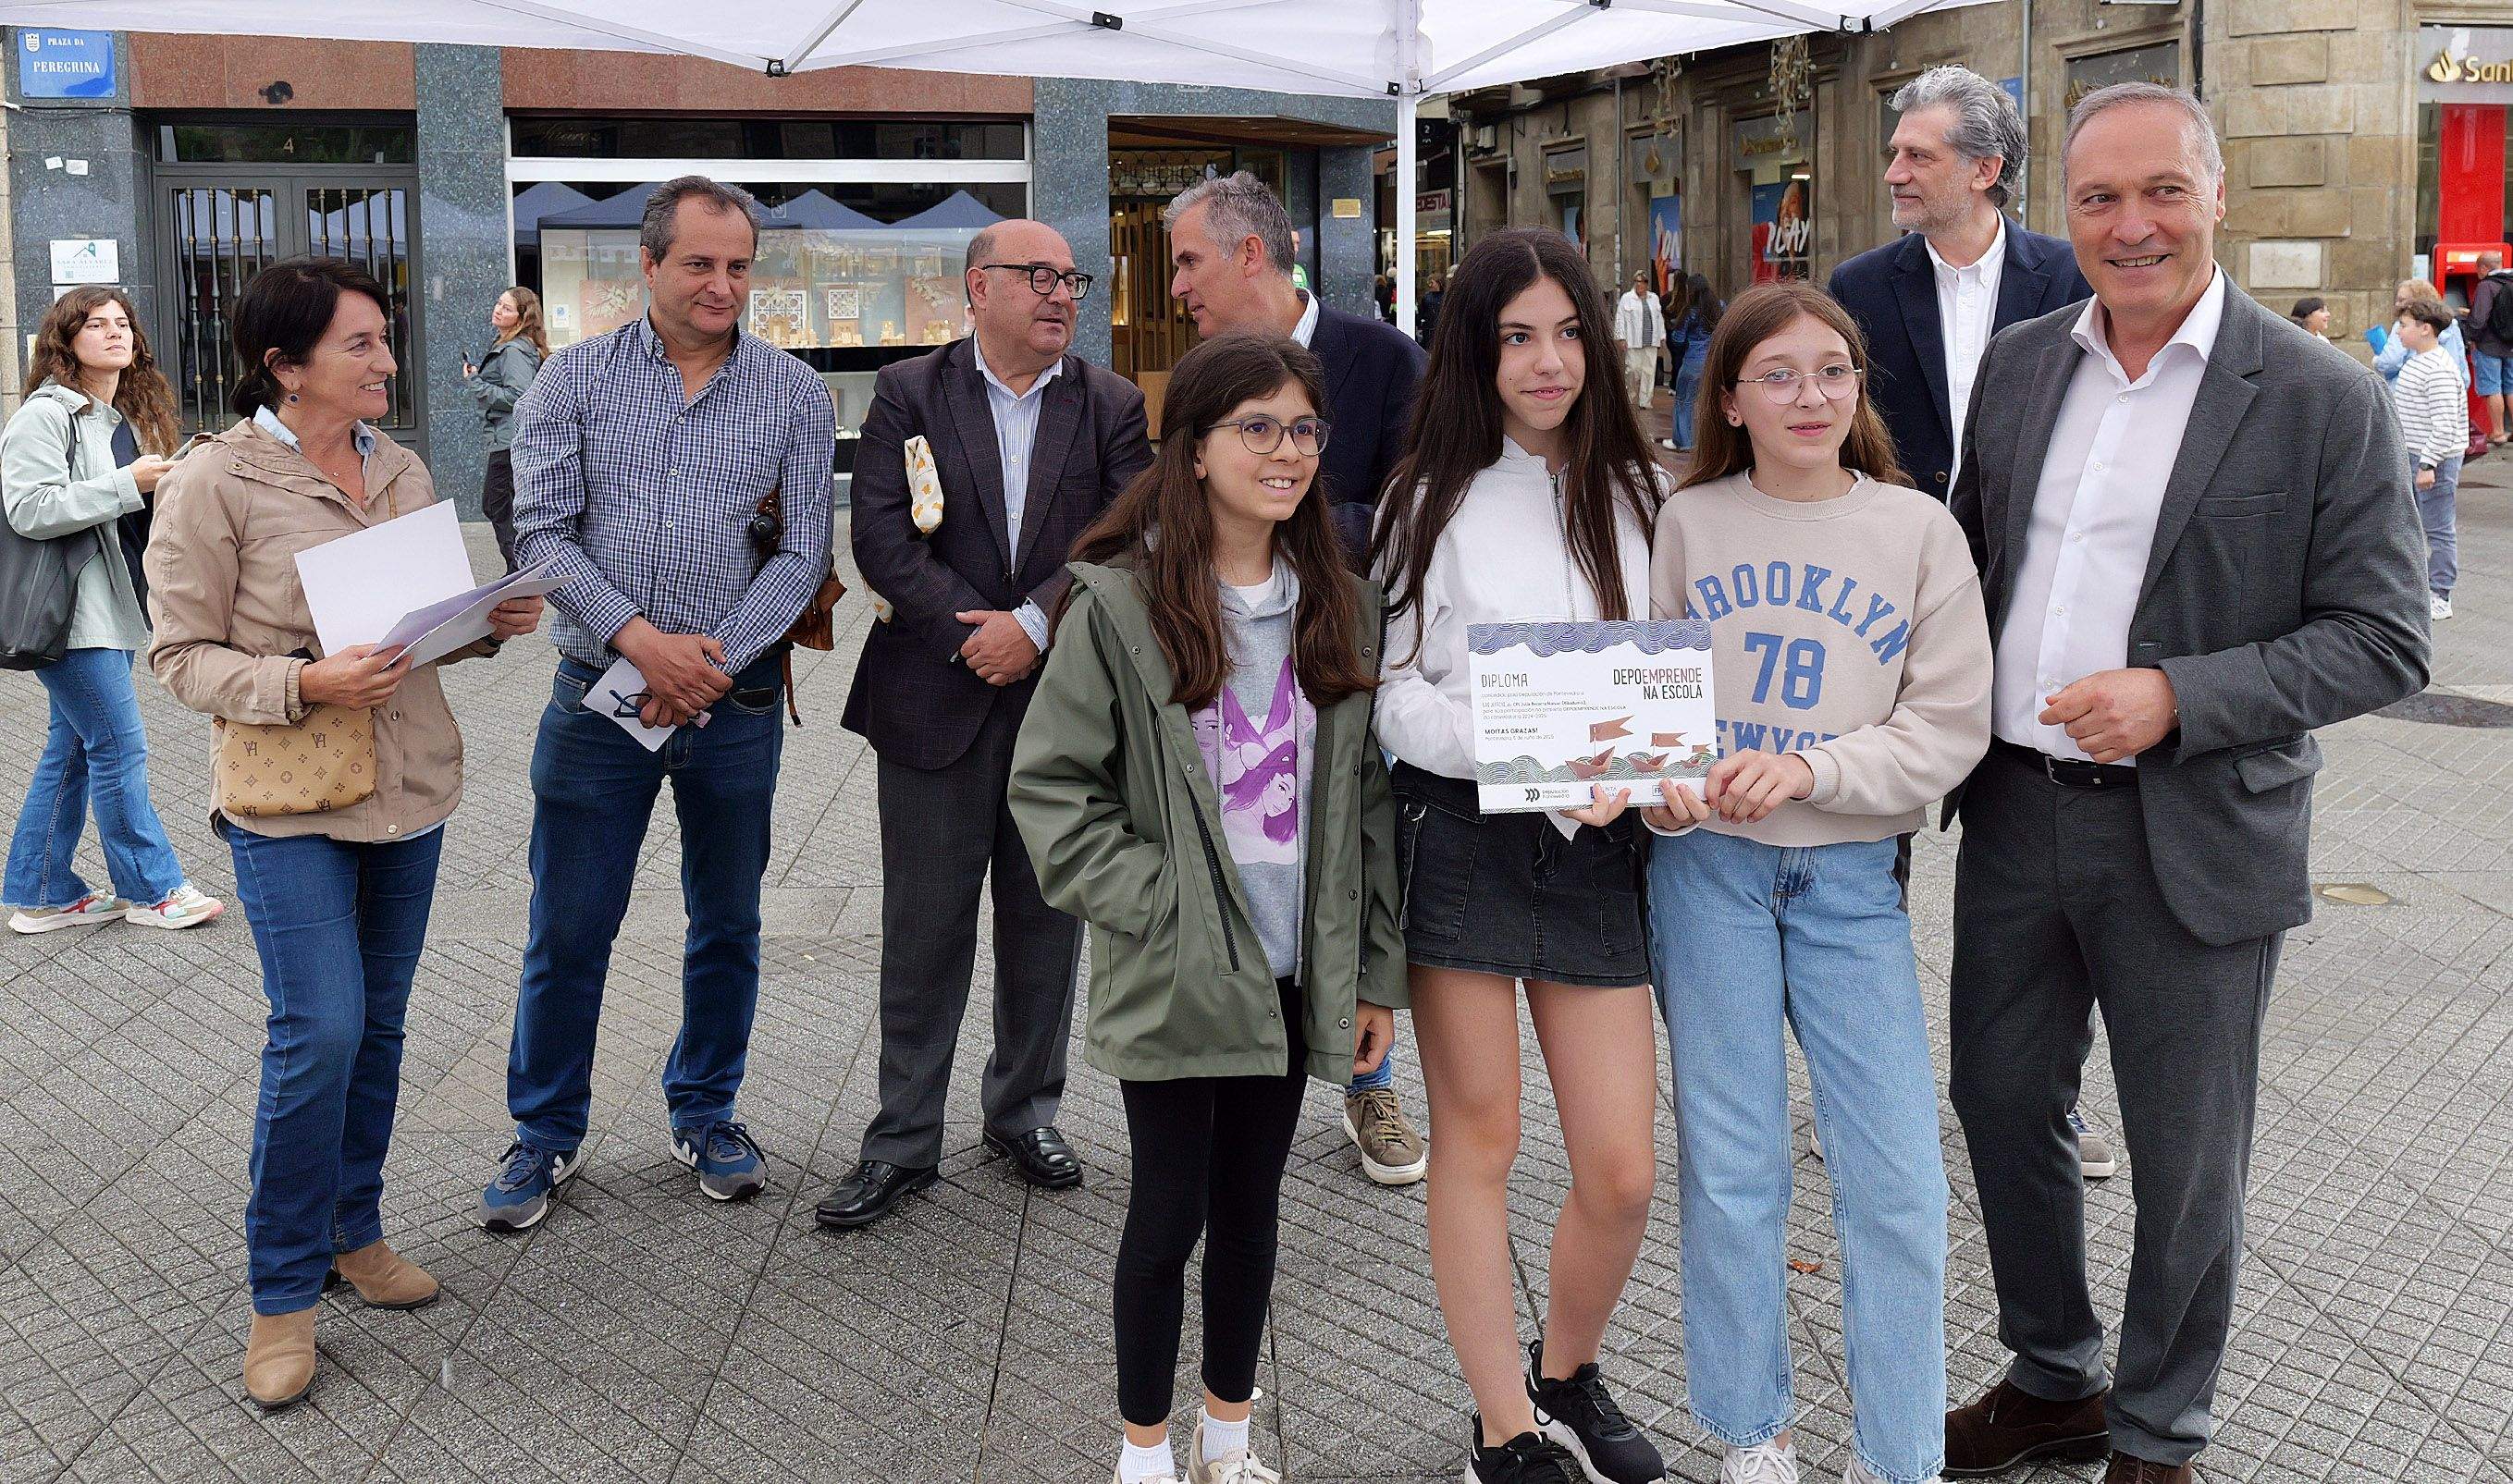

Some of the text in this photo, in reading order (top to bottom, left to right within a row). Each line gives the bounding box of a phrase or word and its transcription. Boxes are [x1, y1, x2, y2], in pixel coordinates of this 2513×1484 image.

[47, 37, 85, 46] PRAZA DA
[33, 61, 100, 73] PEREGRINA
[2465, 55, 2513, 83] San
[283, 136, 294, 153] 4
[1767, 217, 1811, 254] PLAY
[1613, 668, 1702, 685] DEPOEMPRENDE
[1744, 632, 1827, 710] 78
[1481, 673, 1528, 688] DIPLOMA
[1643, 684, 1703, 700] NA ESCOLA
